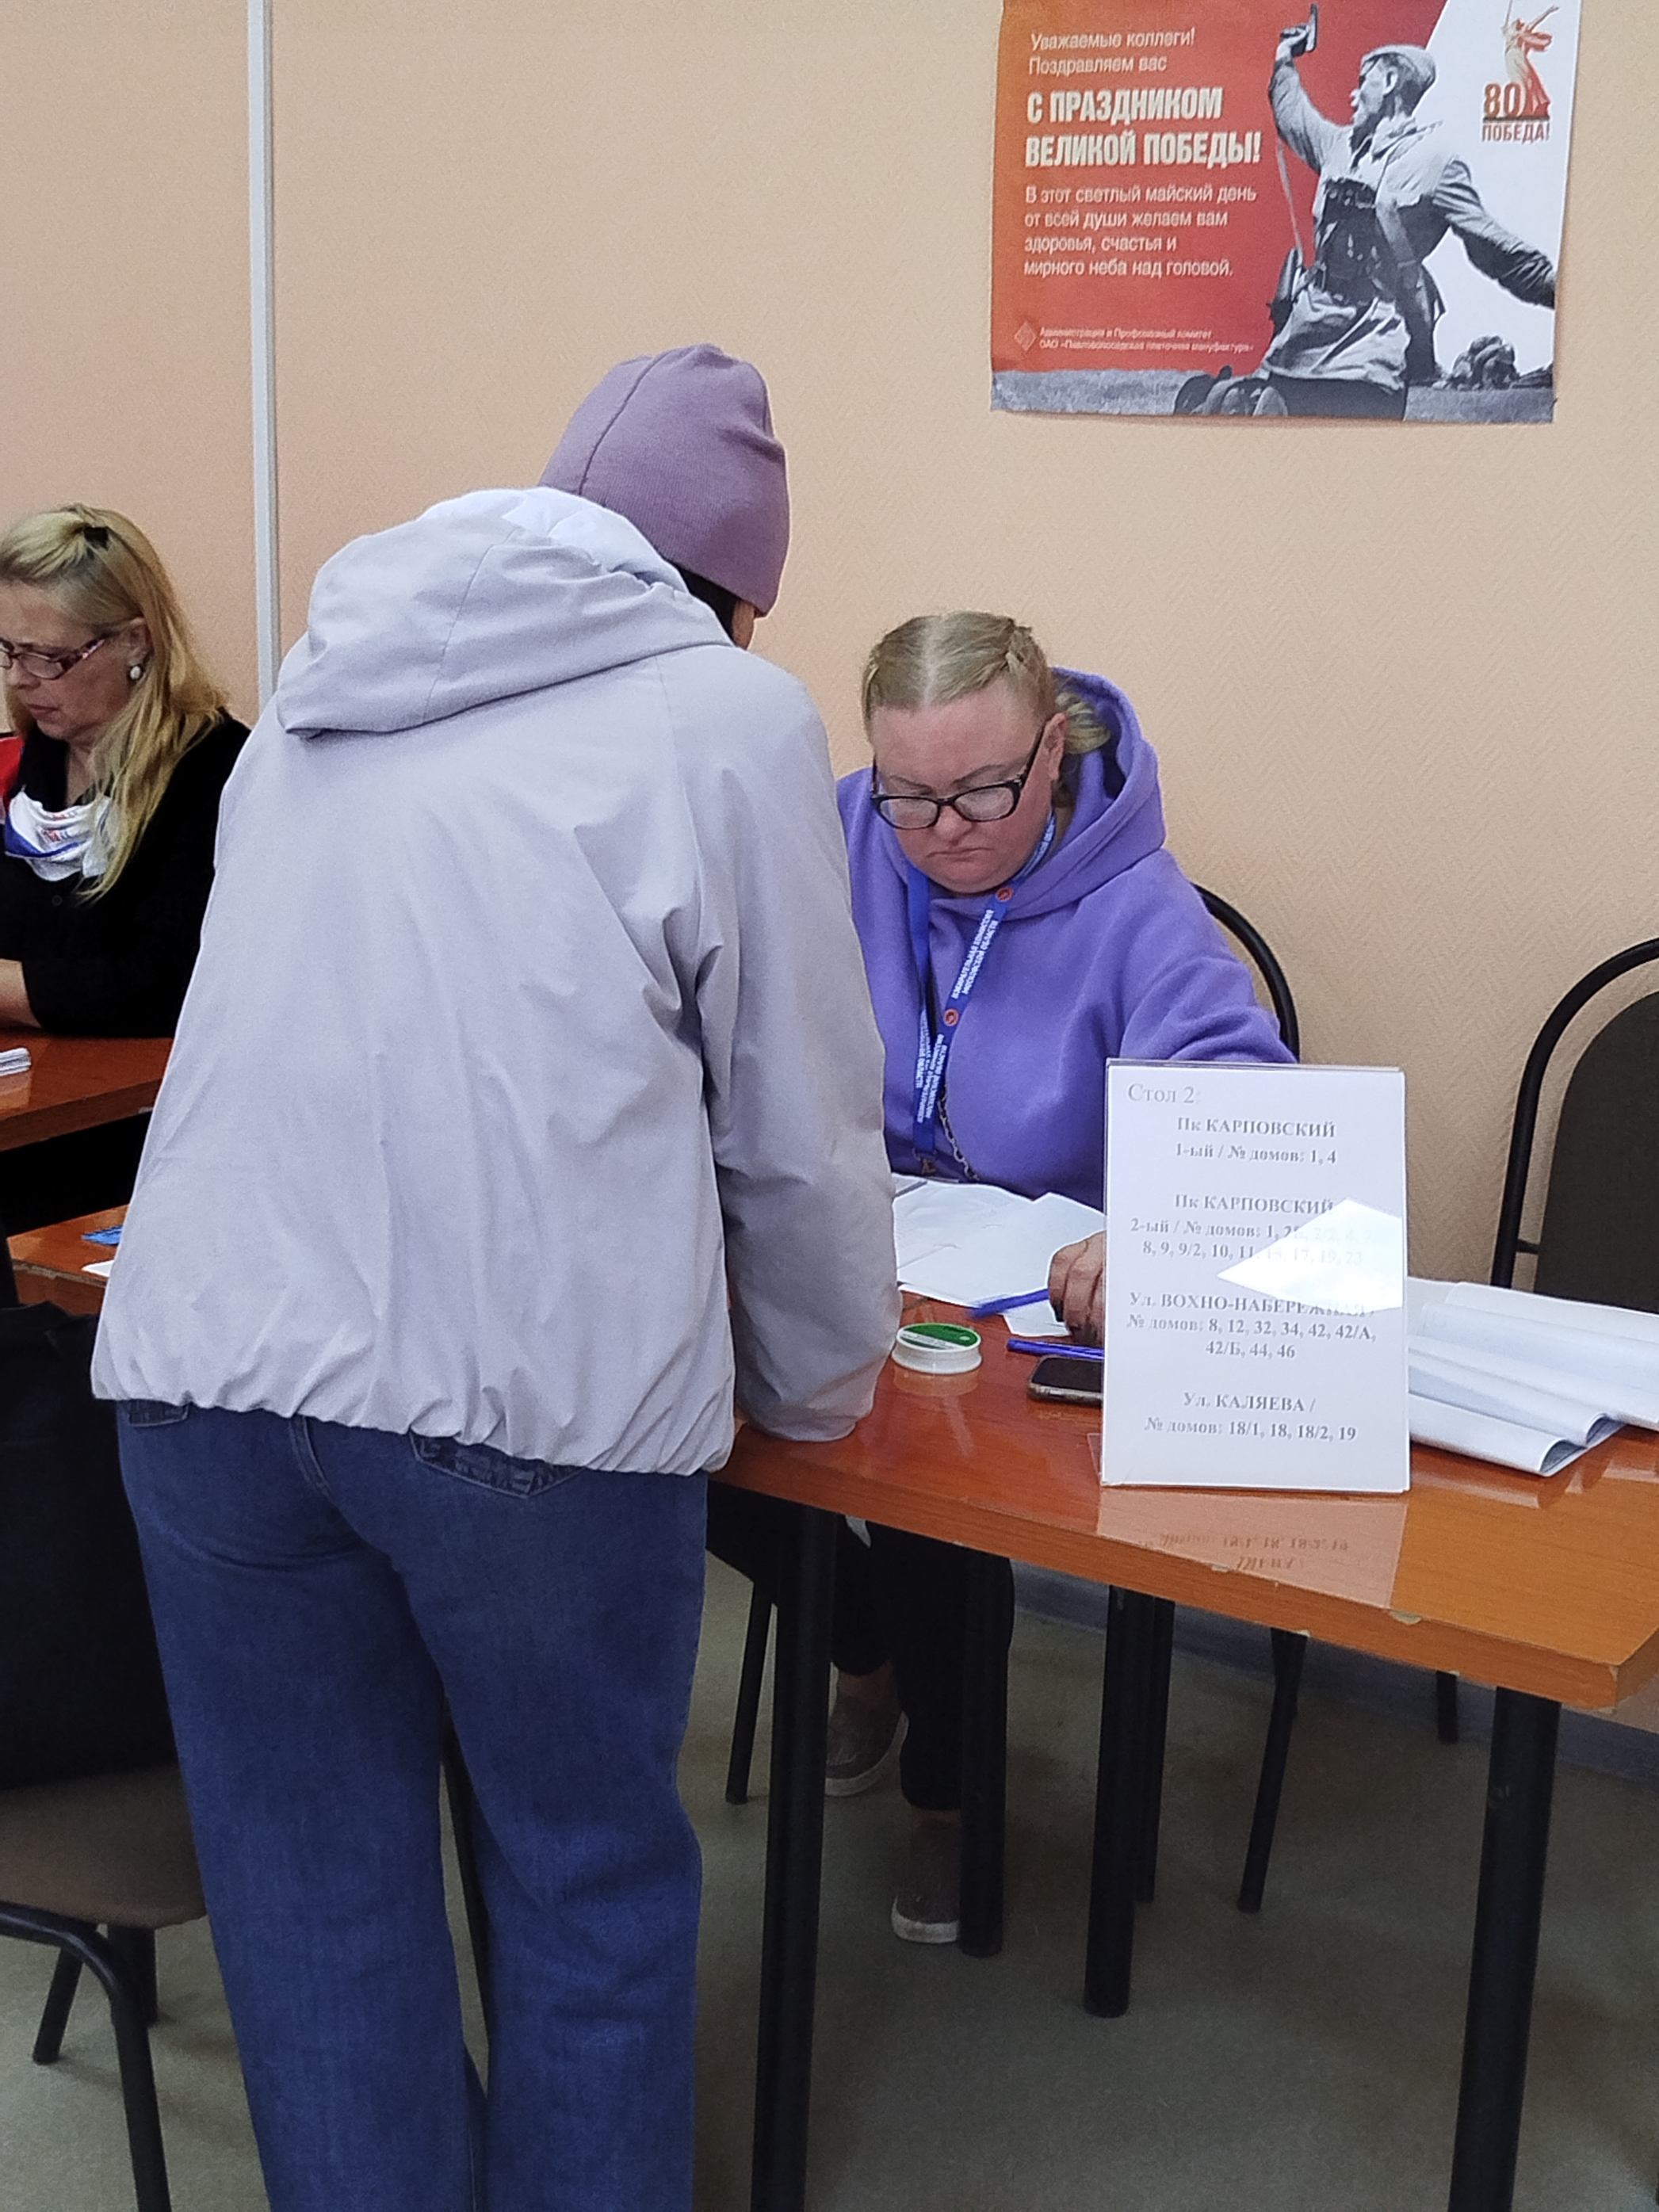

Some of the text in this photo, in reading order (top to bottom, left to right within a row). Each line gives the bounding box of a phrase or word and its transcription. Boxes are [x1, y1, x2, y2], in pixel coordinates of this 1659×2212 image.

[1031, 27, 1195, 51] Уважаемые коллеги!
[1029, 56, 1168, 77] Поздравляем вас
[1026, 86, 1224, 126] С ПРАЗДНИКОМ
[1484, 82, 1522, 118] 80
[1481, 122, 1550, 144] ПОБЕДА!
[1025, 129, 1262, 170] ВЕЛИКОЙ ПОБЕДЫ!
[1026, 185, 1257, 204] В этот светлый майский день
[1025, 207, 1229, 231] от всей души желаем вам
[1024, 236, 1177, 254] здоровья, счастья и
[1024, 258, 1233, 278] мирного неба над головой.
[1128, 1083, 1177, 1103] Стол
[1177, 1117, 1336, 1138] Пк КАРПОВСКИЙ
[1176, 1144, 1214, 1158] 1-ый
[1228, 1145, 1246, 1159] №
[1310, 1150, 1324, 1165] 1,
[1327, 1150, 1336, 1163] 4
[1175, 1194, 1333, 1214] Пк КАРПОВСКИЙ
[1131, 1218, 1169, 1232] 2-ый
[1183, 1221, 1202, 1234] №
[1143, 1240, 1156, 1256] 8,
[1161, 1242, 1174, 1258] 9,
[1179, 1243, 1206, 1259] 9/2,
[1213, 1244, 1233, 1260] 10,
[1130, 1292, 1156, 1307] Ул.
[1127, 1314, 1145, 1328] №
[1209, 1318, 1222, 1334] 8,
[1228, 1319, 1249, 1335] 12,
[1253, 1320, 1276, 1337] 32,
[1281, 1322, 1304, 1338] 34,
[1308, 1323, 1331, 1339] 42,
[1249, 1343, 1273, 1359] 44,
[1277, 1344, 1295, 1358] 46
[1183, 1393, 1210, 1408] Ул.
[1216, 1394, 1305, 1412] КАЛЯЕВА
[1145, 1417, 1163, 1431] №
[1229, 1421, 1264, 1438] 18/1,
[1271, 1423, 1292, 1439] 18,
[1298, 1424, 1333, 1442] 18/2,
[1338, 1427, 1356, 1440] 19
